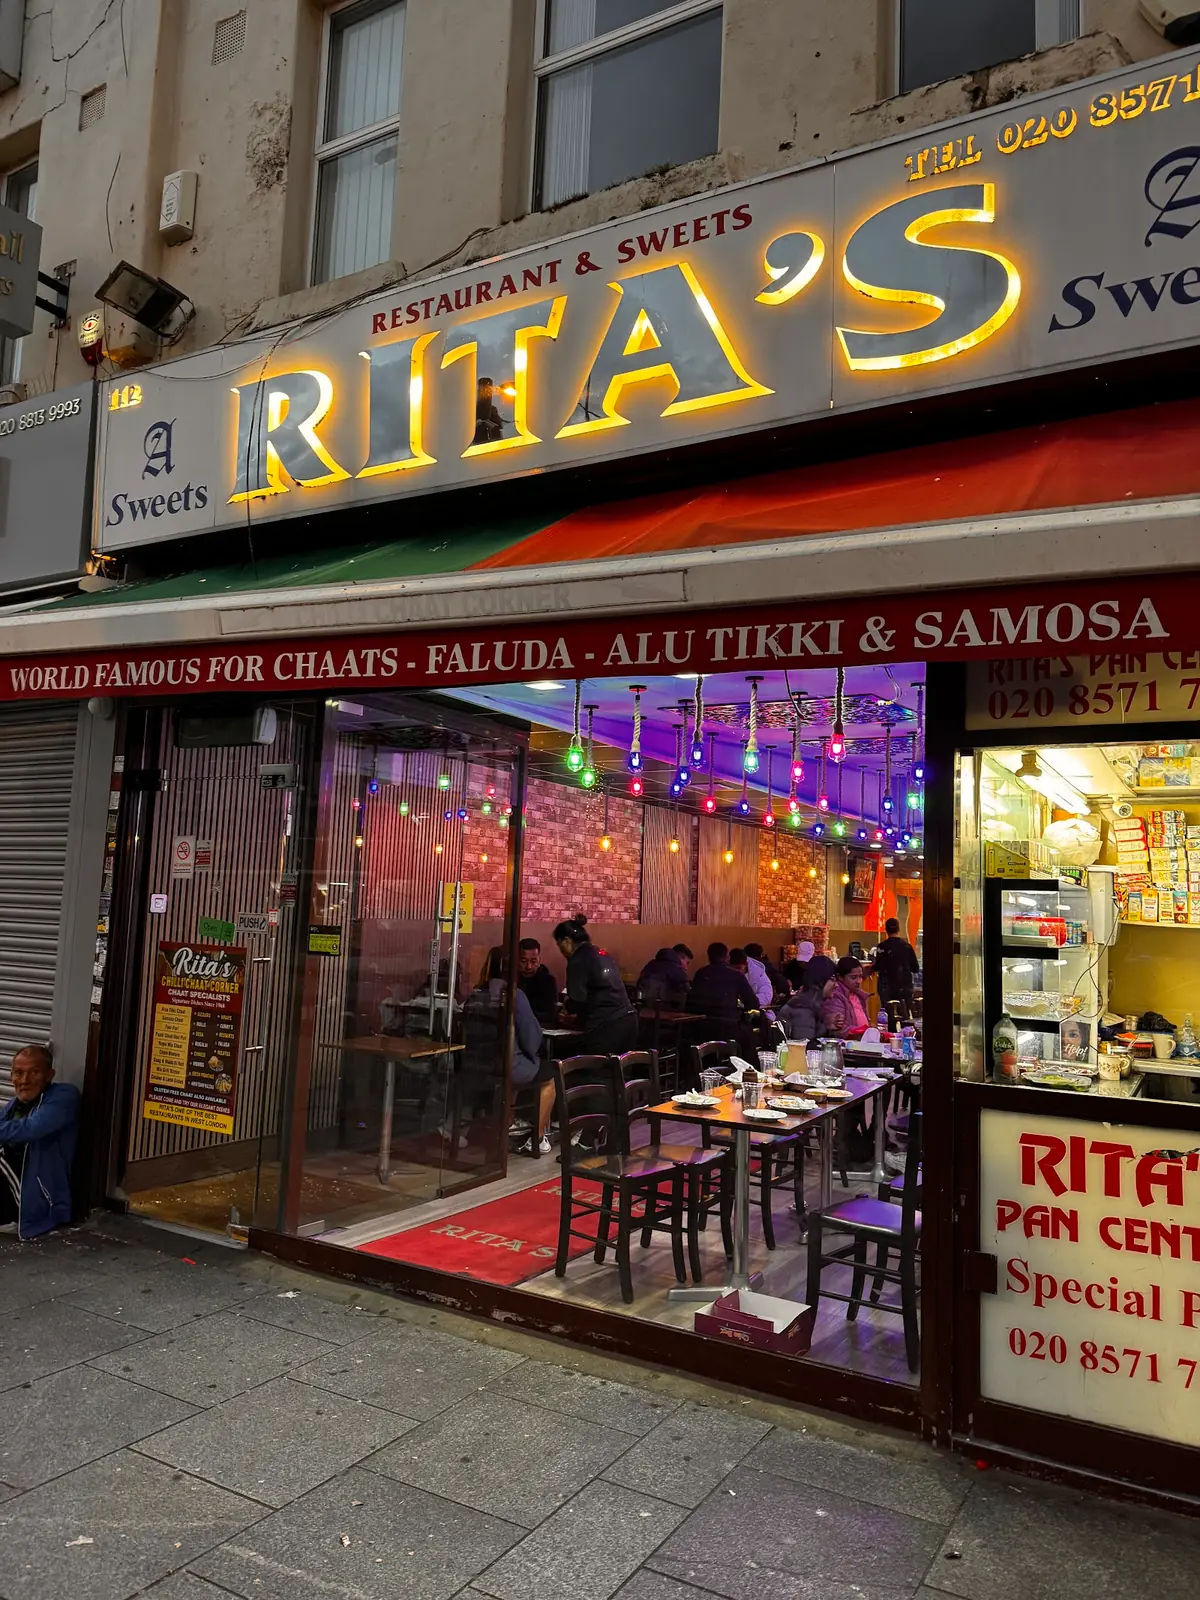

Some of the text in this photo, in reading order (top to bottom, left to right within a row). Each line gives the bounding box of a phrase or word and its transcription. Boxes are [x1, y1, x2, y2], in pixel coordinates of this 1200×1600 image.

[905, 135, 982, 181] TEL
[997, 106, 1077, 153] 020
[372, 203, 753, 334] RESTAURANT & SWEETS
[227, 182, 1021, 504] RITA'S
[108, 384, 143, 411] 112
[18, 409, 45, 430] 8813
[49, 398, 81, 421] 9993
[105, 482, 208, 527] Sweets
[464, 586, 571, 615] CORNER
[10, 664, 89, 692] WORLD
[93, 657, 201, 688] FAMOUS
[206, 655, 265, 682] FOR
[273, 647, 399, 682] CHAATS
[425, 637, 575, 675] FALUDA
[603, 630, 696, 666] ALU
[705, 619, 845, 663] TIKKI
[858, 615, 896, 653] &
[913, 597, 1170, 649] SAMOSA
[1089, 652, 1147, 677] PAN
[987, 687, 1054, 720] 020
[1068, 680, 1161, 716] 8571
[203, 921, 217, 933] Open
[239, 916, 259, 929] PUSH
[172, 947, 237, 979] Rita's
[161, 975, 239, 994] CHILLI CHAAT CORNER
[168, 988, 231, 1002] CHAAT SPECIALISTS
[1064, 1043, 1088, 1060] Help!
[148, 1093, 162, 1101] PLEASE
[198, 1103, 216, 1111] ELEGANT
[204, 1112, 218, 1120] BEST
[149, 1109, 183, 1121] RESTAURANTS
[190, 1117, 204, 1125] WEST
[205, 1119, 228, 1129] LONDON
[996, 1198, 1079, 1243] PAN
[430, 1223, 558, 1258] RITA'S
[1006, 1256, 1164, 1323] Special
[1008, 1326, 1198, 1389] 020 8571 7
